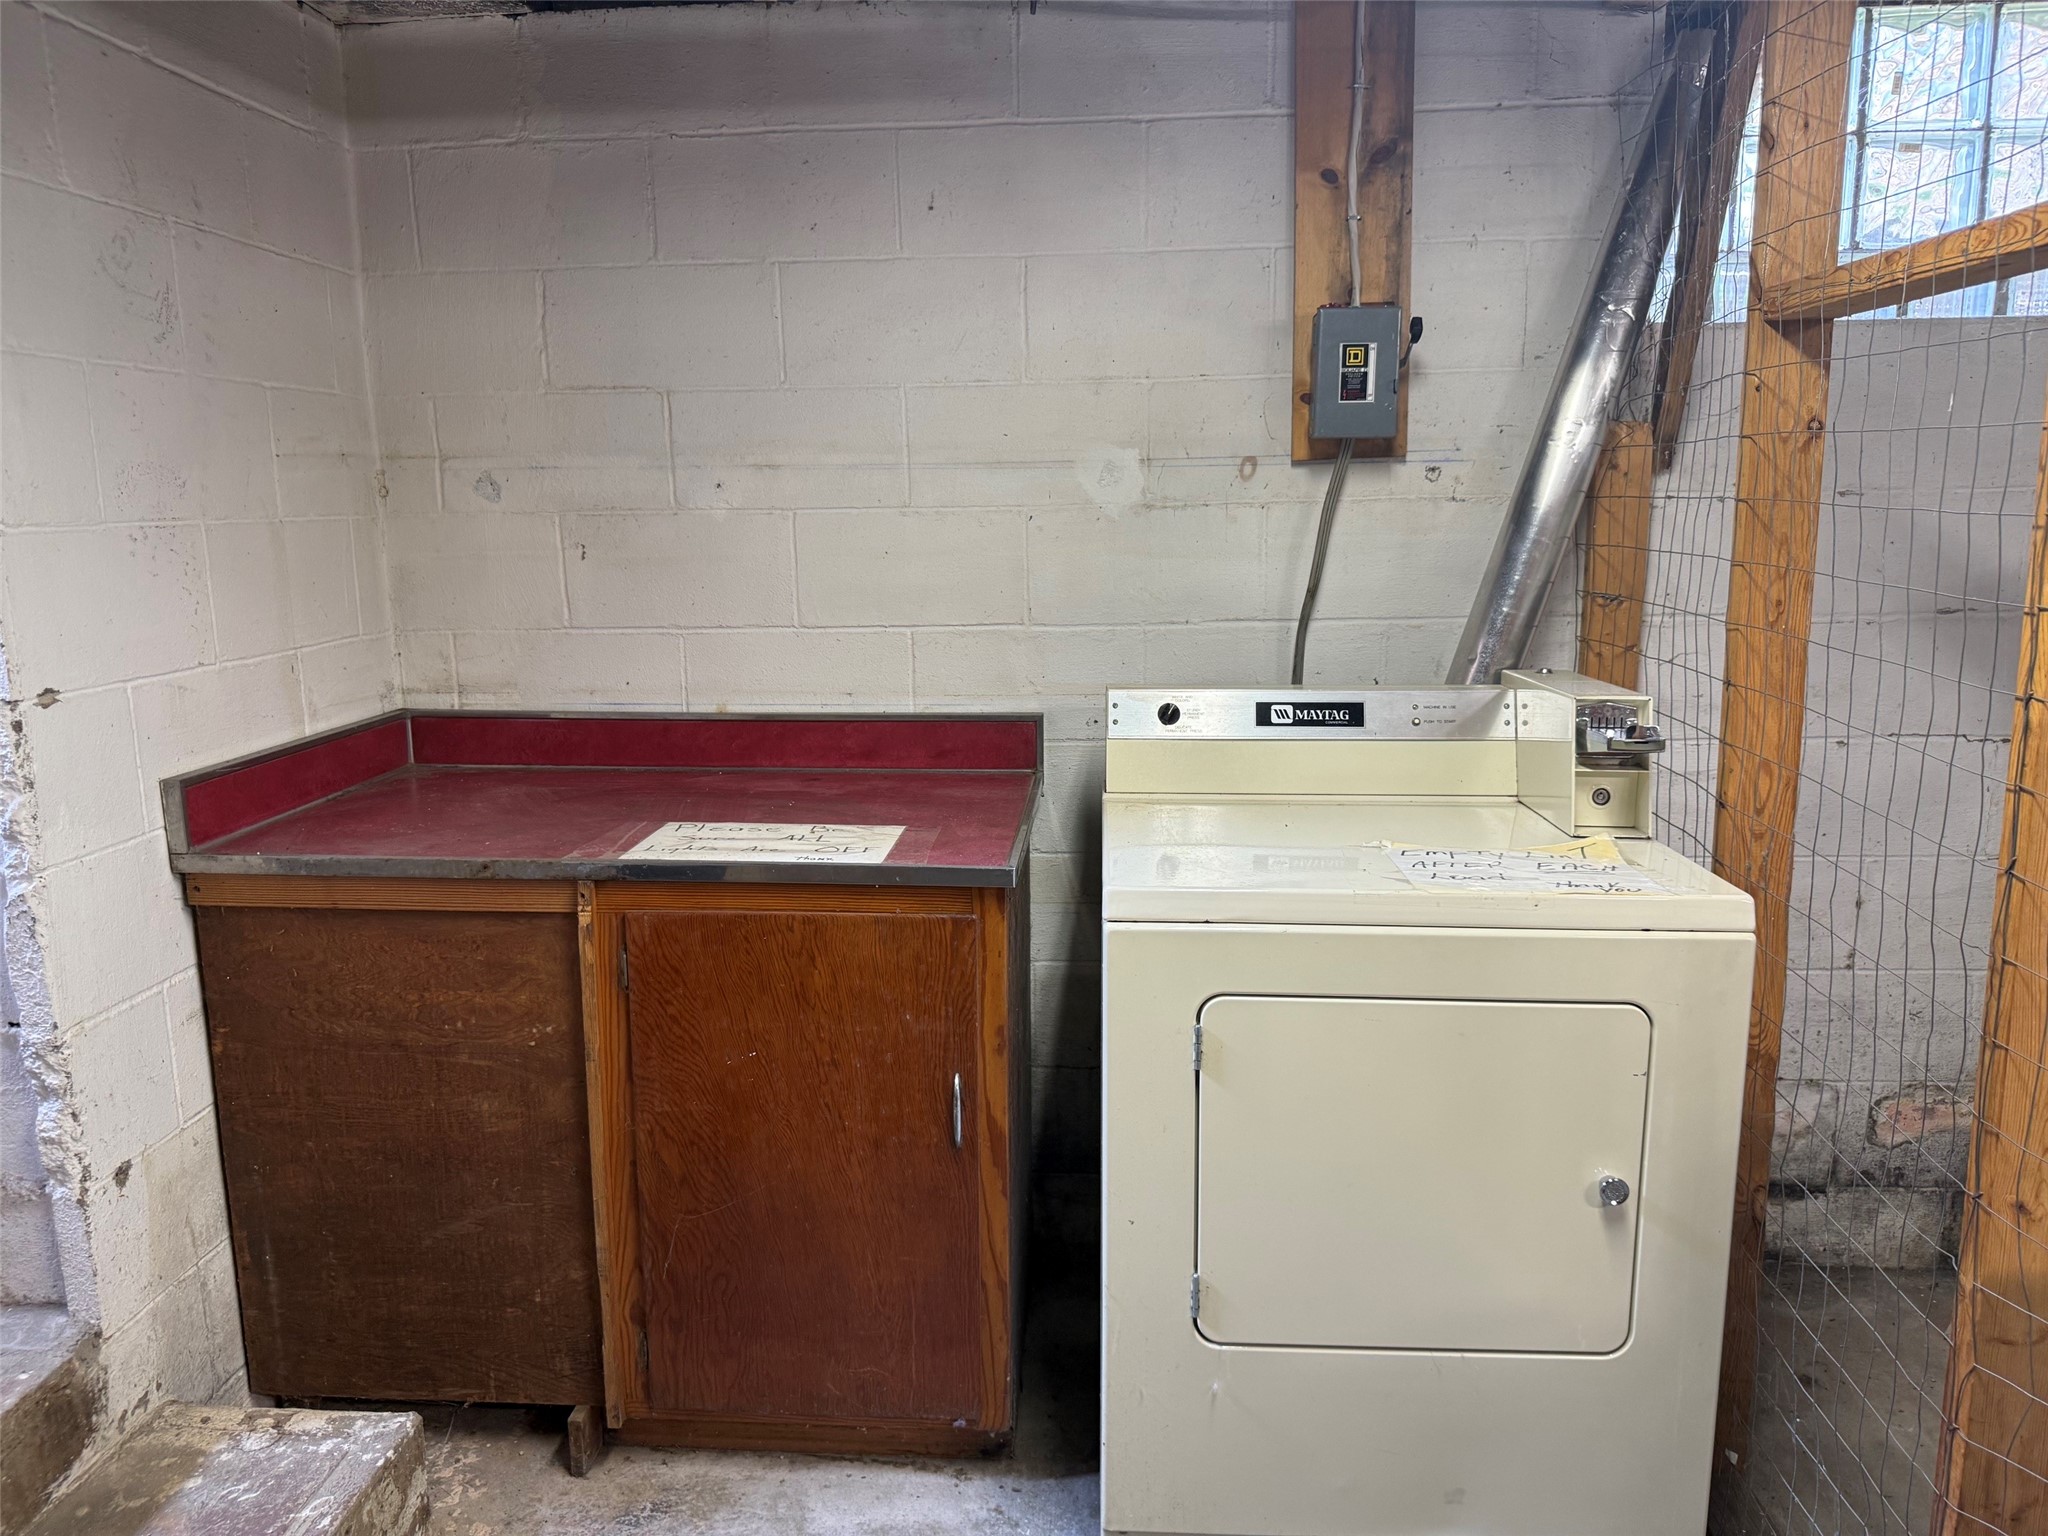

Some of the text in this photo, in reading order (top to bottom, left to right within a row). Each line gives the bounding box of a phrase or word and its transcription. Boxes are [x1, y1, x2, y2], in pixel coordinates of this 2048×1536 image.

[1349, 350, 1361, 363] D
[1294, 709, 1349, 720] MAYTAG
[674, 823, 785, 832] Please
[643, 845, 718, 854] Lights
